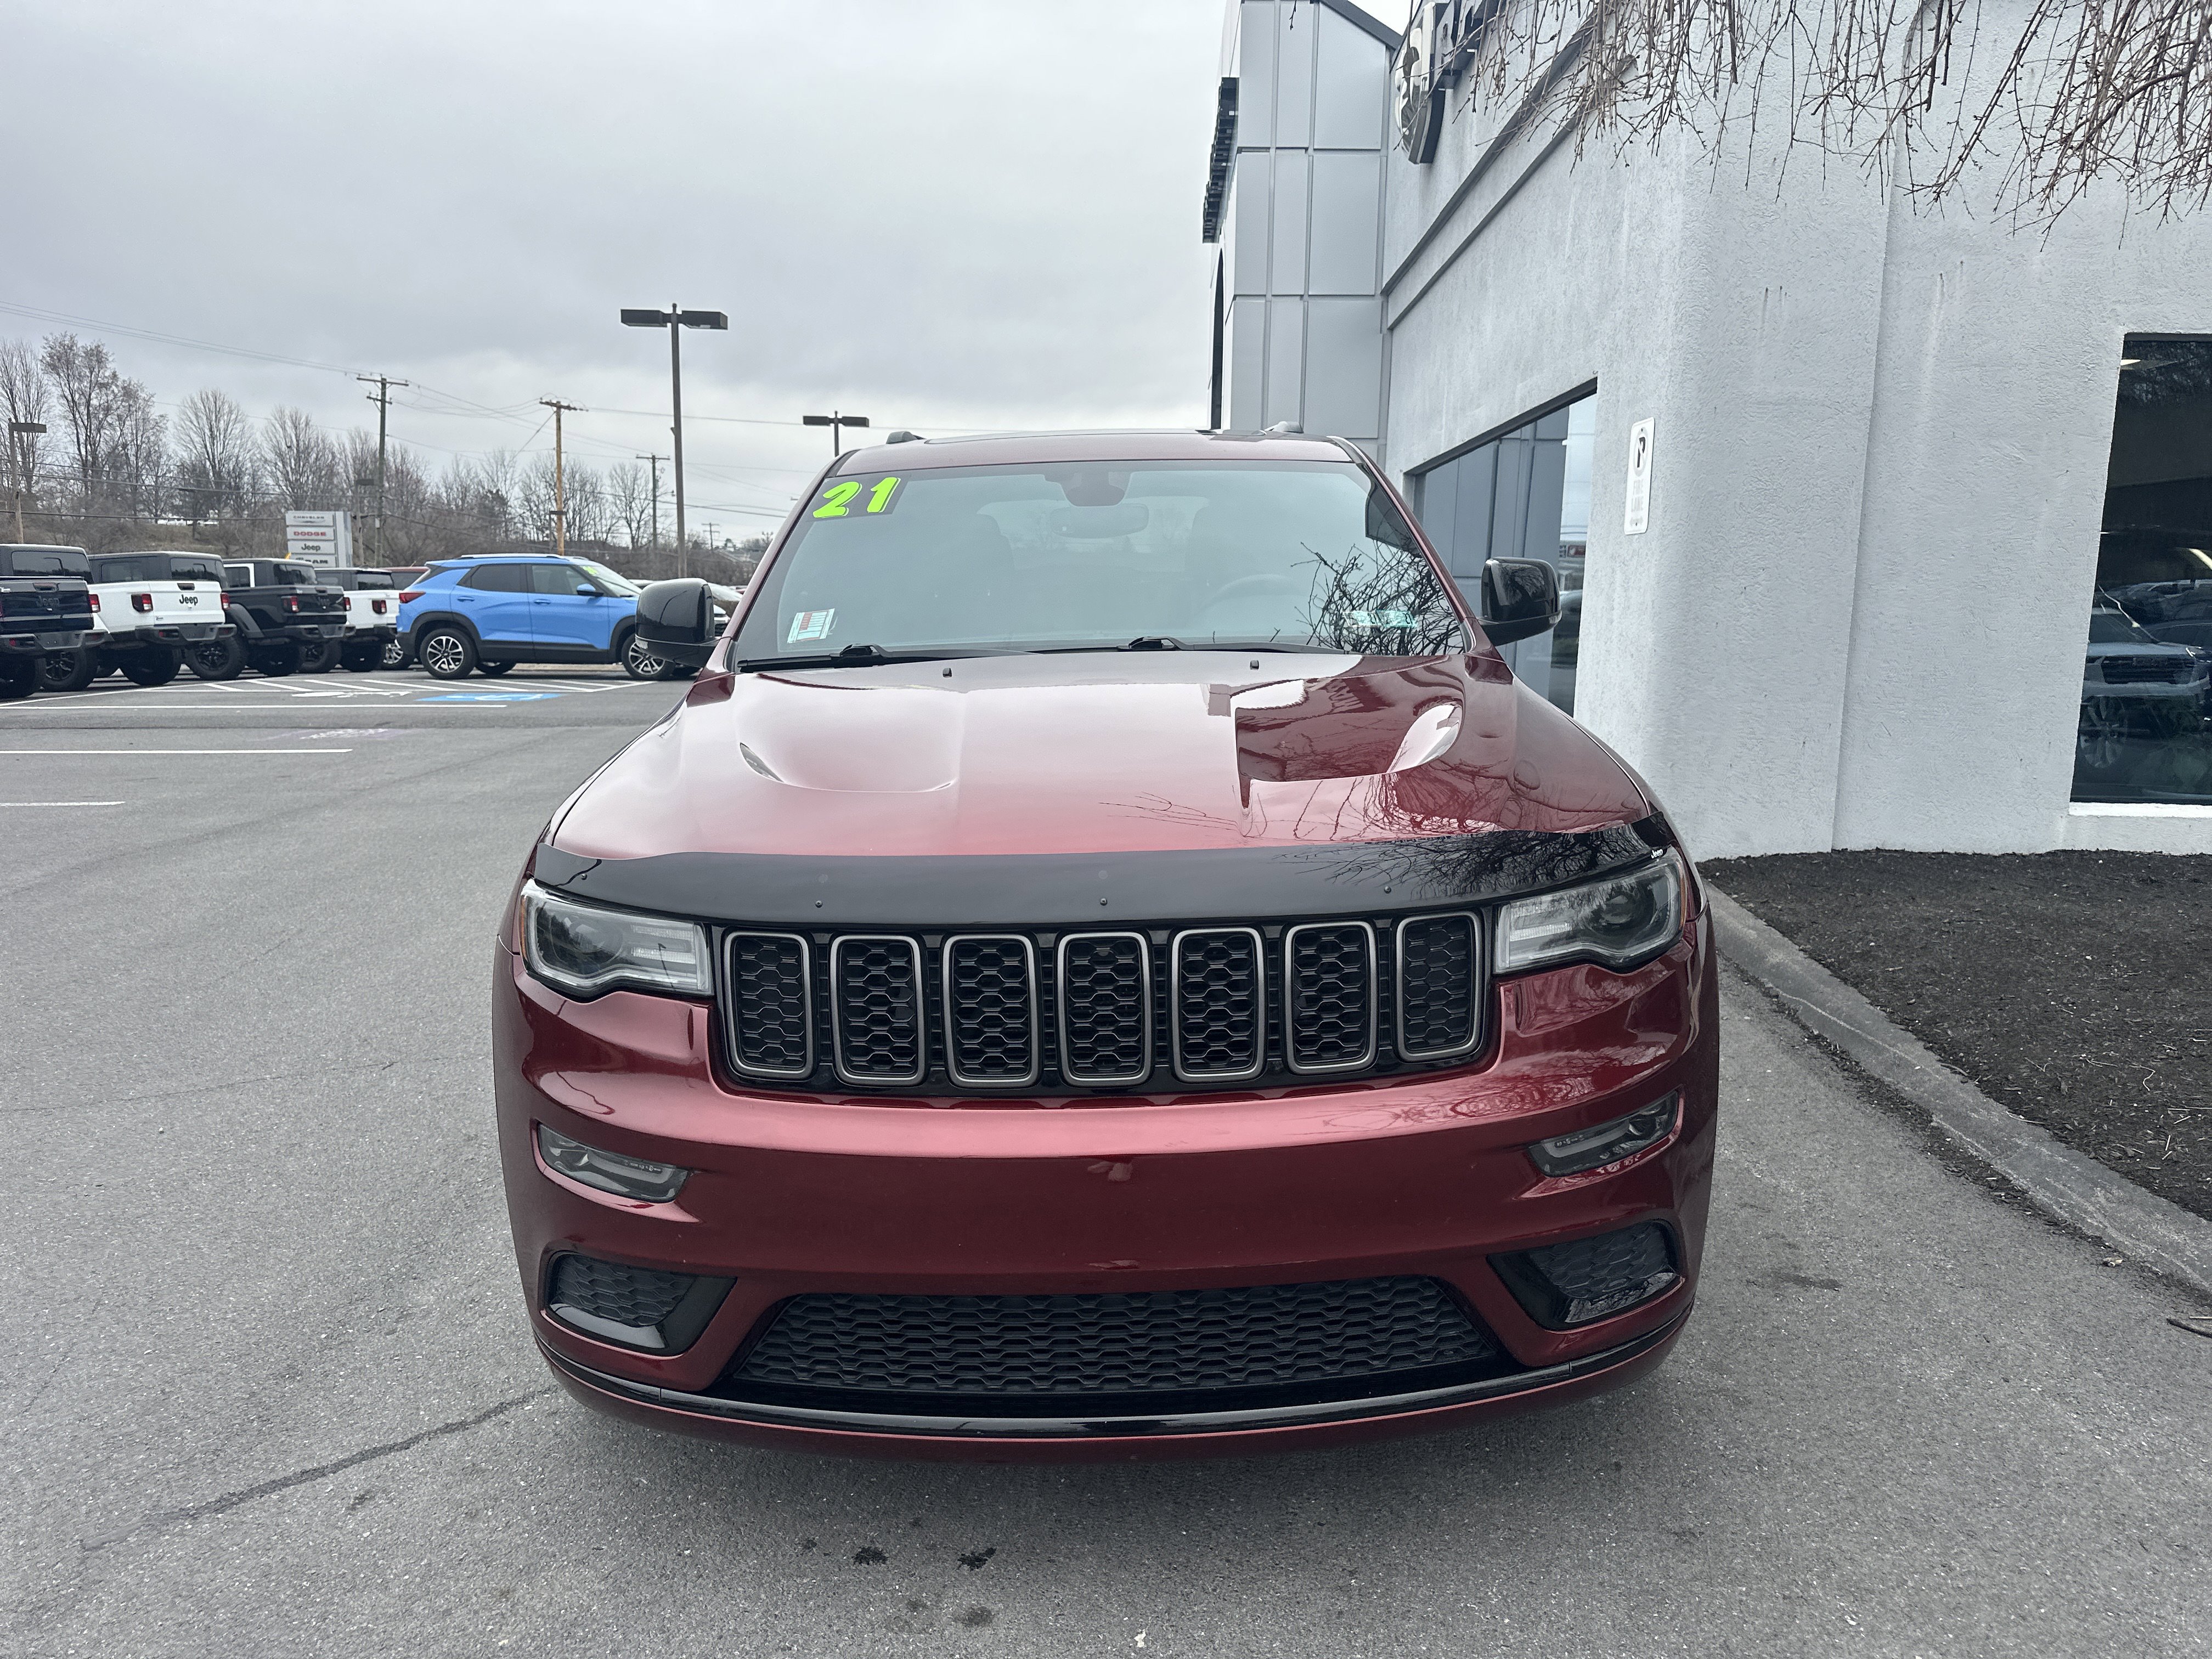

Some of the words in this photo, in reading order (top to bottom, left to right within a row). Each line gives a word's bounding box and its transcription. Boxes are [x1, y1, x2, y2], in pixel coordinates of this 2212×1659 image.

[813, 477, 901, 518] 21
[301, 543, 321, 552] Jeep
[179, 594, 198, 606] Jeep
[1651, 849, 1663, 859] Jeep
